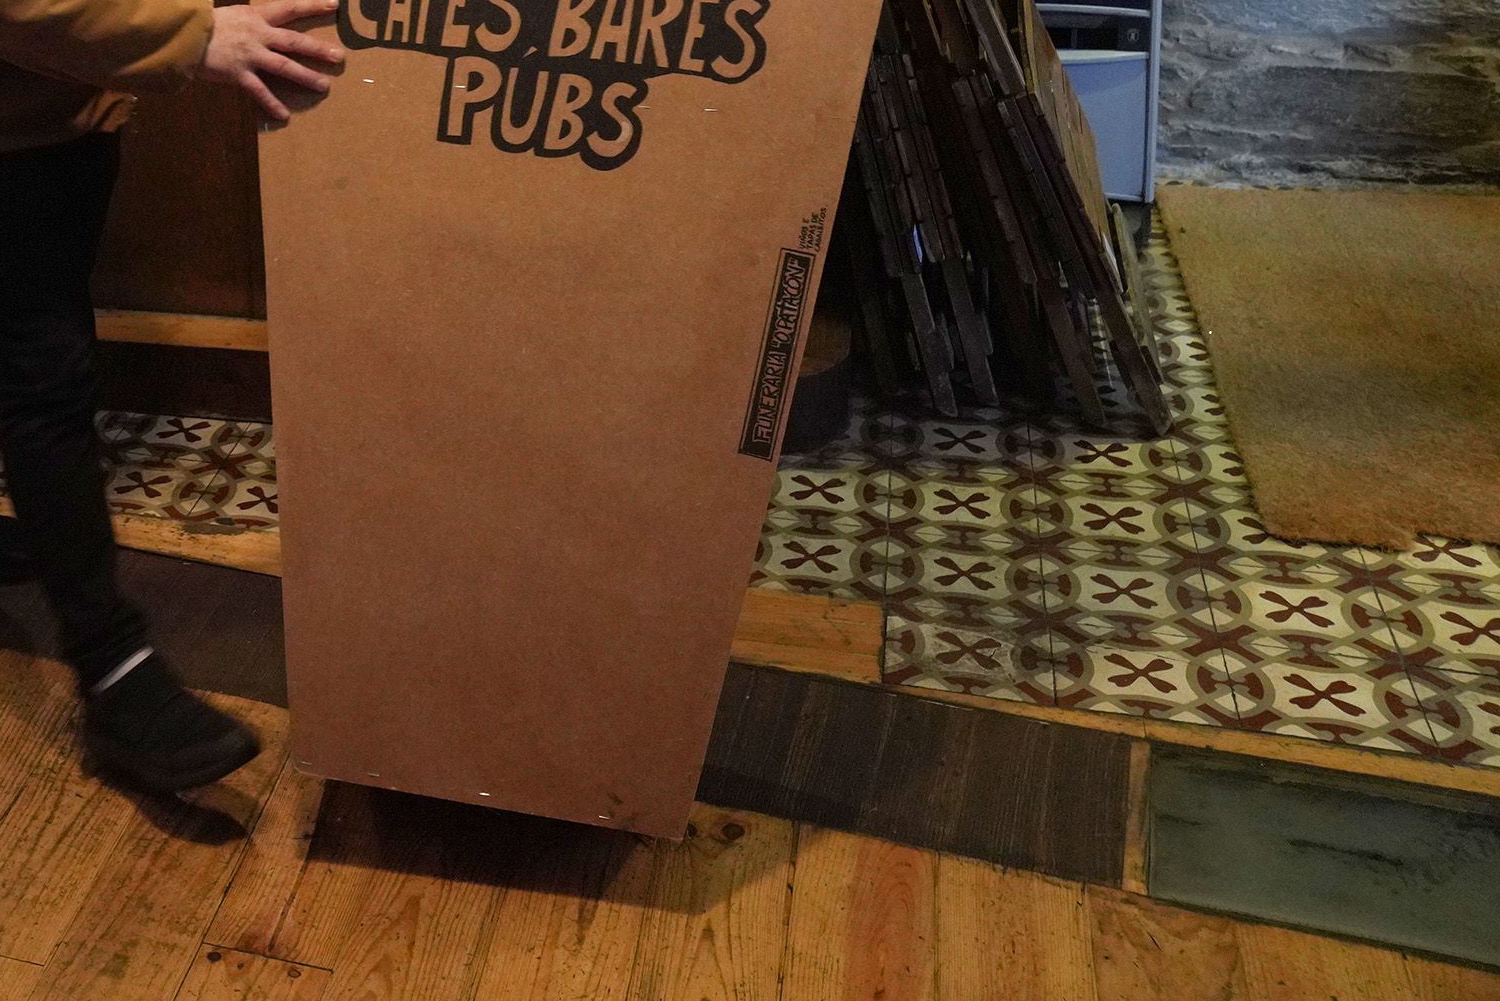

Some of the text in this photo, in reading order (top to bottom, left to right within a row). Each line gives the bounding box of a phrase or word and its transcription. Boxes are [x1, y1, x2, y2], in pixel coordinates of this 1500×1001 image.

[445, 55, 641, 159] PUBS
[808, 224, 816, 249] TAPAS
[752, 352, 787, 443] FUNERARIA
